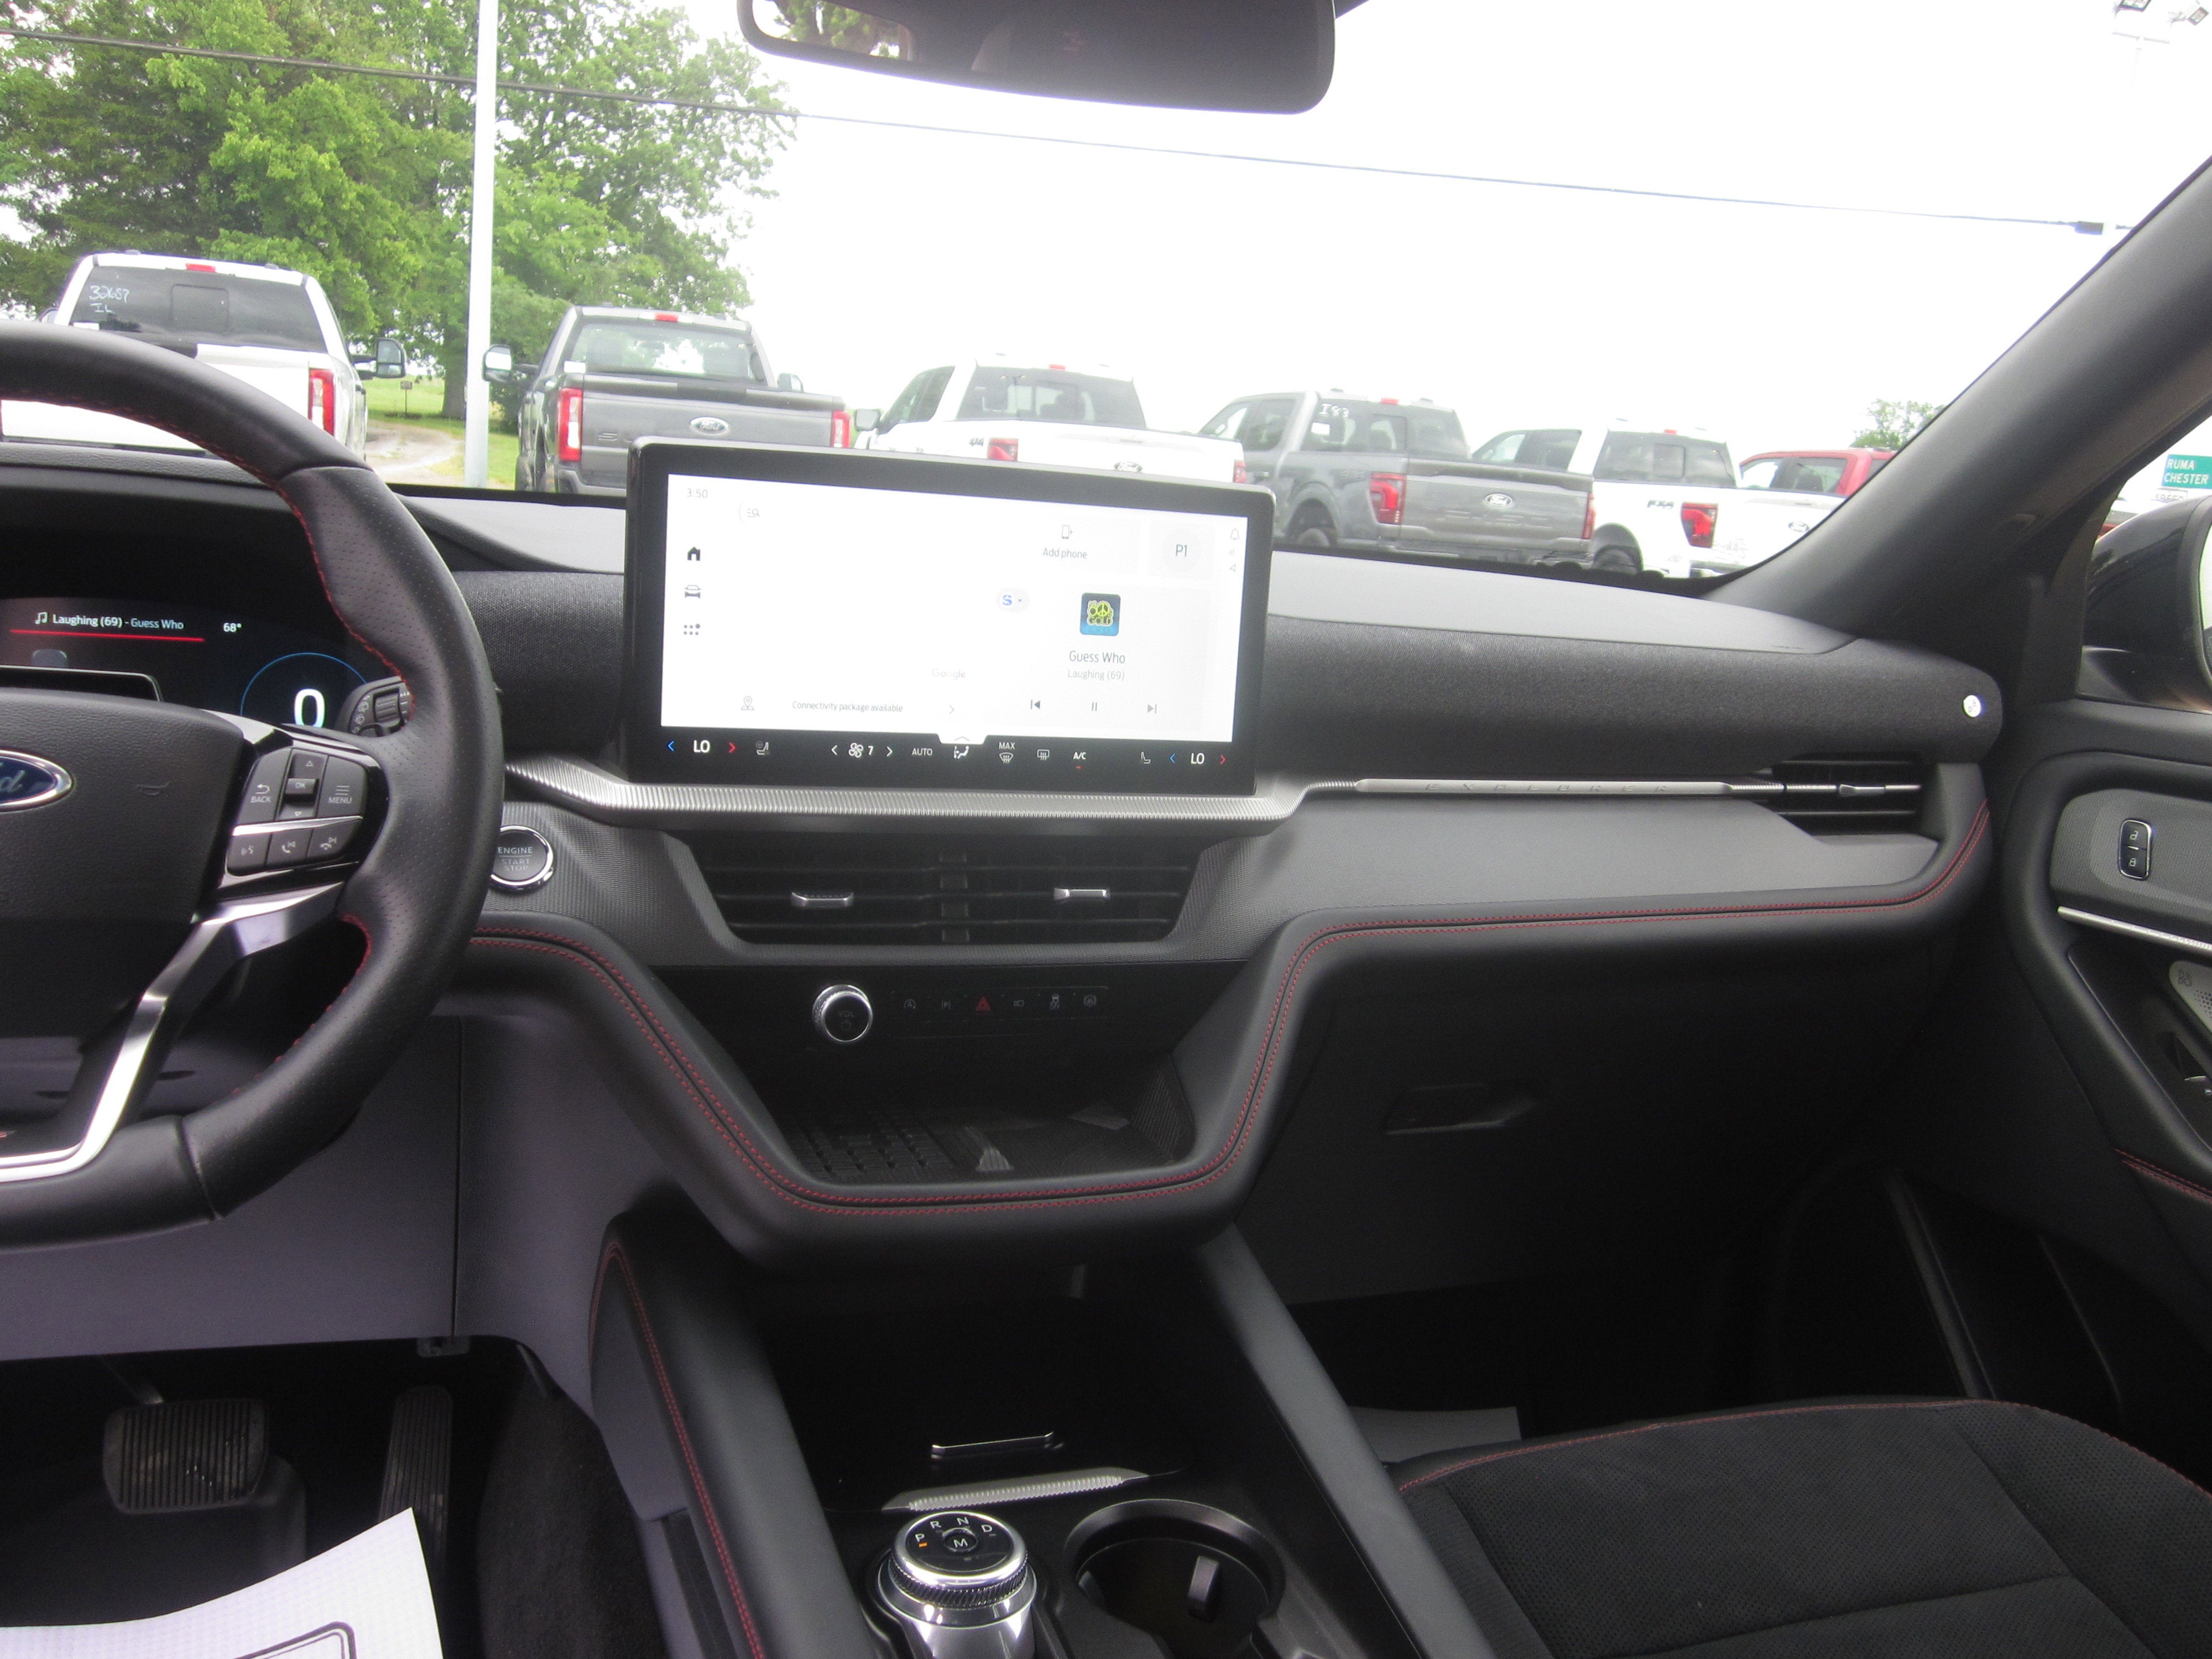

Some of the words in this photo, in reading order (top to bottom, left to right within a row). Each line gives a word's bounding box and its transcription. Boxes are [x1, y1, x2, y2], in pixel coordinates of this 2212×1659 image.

[2167, 458, 2195, 470] RUMA
[2163, 472, 2209, 485] CHESTER
[686, 488, 708, 499] 3:50
[1042, 547, 1060, 557] Add
[1061, 549, 1088, 559] phone
[1175, 544, 1188, 557] P1
[53, 614, 98, 627] Laughing
[100, 616, 123, 628] (69)
[131, 618, 160, 629] Guess
[161, 619, 184, 630] Who
[1088, 617, 1112, 625] GOLD
[223, 622, 242, 633] 68°
[1069, 650, 1099, 663] Guess
[1102, 651, 1126, 664] Who
[931, 667, 966, 680] Google
[1068, 669, 1105, 680] Laughing
[1107, 670, 1125, 681] (69)
[294, 688, 325, 728] 0
[792, 701, 837, 712] Connectivity
[838, 702, 869, 713] package
[870, 703, 904, 712] available
[693, 740, 711, 753] LO
[868, 746, 874, 755] 7
[912, 747, 933, 757] AUTO
[999, 742, 1015, 750] MAX
[1073, 752, 1087, 761] A/C
[1191, 753, 1204, 765] LO
[915, 1533, 926, 1542] P
[930, 1521, 942, 1530] R
[957, 1516, 969, 1525] N
[981, 1524, 993, 1533] D
[953, 1538, 969, 1548] M
